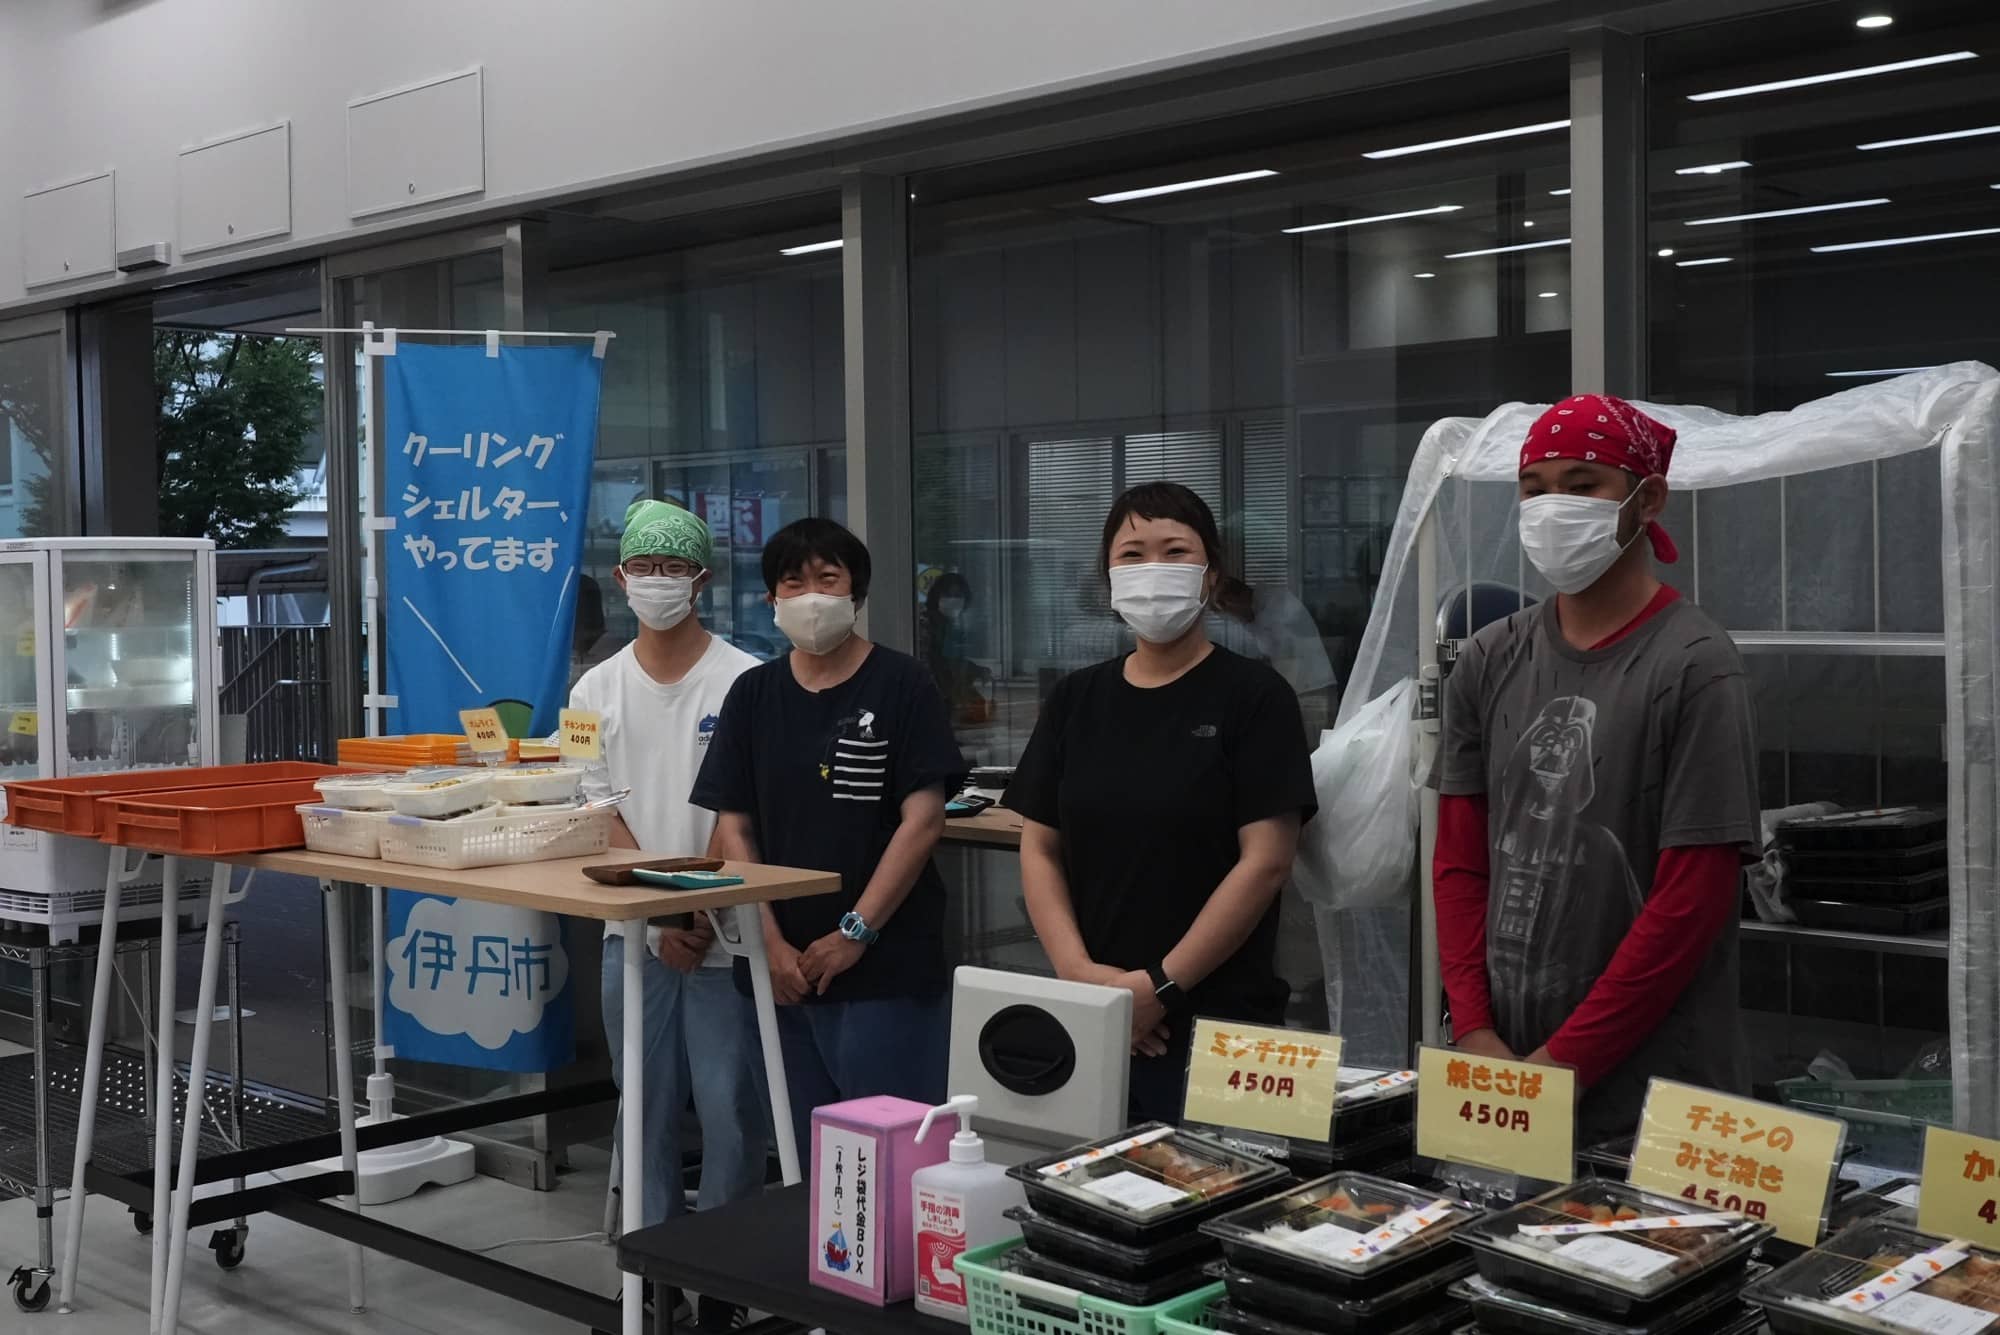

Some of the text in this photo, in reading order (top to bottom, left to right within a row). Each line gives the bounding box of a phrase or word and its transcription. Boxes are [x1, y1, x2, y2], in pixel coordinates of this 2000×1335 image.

[403, 432, 565, 470] クーリング
[402, 484, 568, 523] シェルター、
[403, 534, 559, 573] やってます
[570, 734, 591, 745] 400円
[402, 929, 552, 1000] 伊丹市
[1210, 1031, 1322, 1069] ミンチカツ
[1227, 1070, 1294, 1098] 450円
[1446, 1058, 1543, 1099] 焼きさば
[1459, 1101, 1530, 1132] 450円
[1686, 1105, 1795, 1152] チキンの
[1676, 1142, 1785, 1193] みそ焼き
[1963, 1150, 2000, 1182] か
[856, 1147, 867, 1275] レジ袋代金BOX
